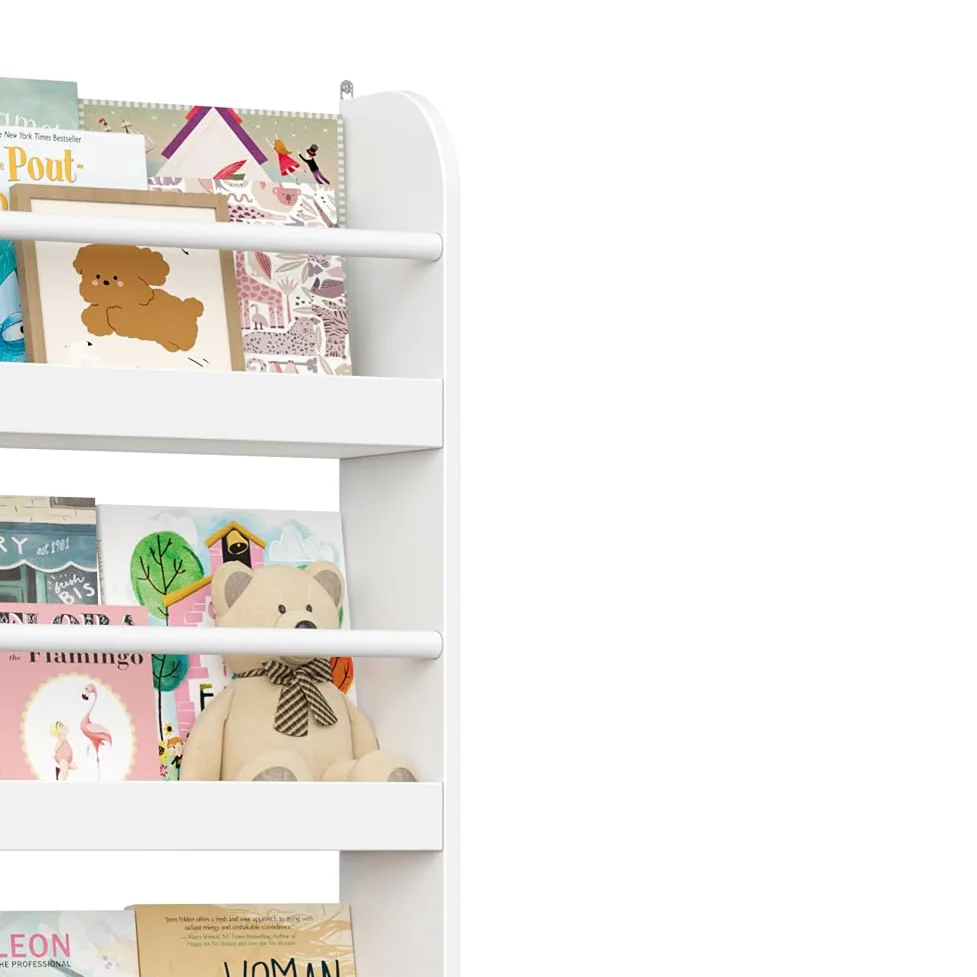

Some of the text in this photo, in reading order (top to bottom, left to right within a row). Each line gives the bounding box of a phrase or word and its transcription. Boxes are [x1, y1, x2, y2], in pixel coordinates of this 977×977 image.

[4, 130, 18, 139] New
[19, 131, 33, 140] York
[34, 132, 52, 142] Times
[52, 133, 82, 143] Bestseller
[50, 537, 71, 554] 1901
[54, 573, 85, 595] fresh
[8, 651, 144, 671] the Flamingo
[11, 959, 72, 969] PROFESSIONAL
